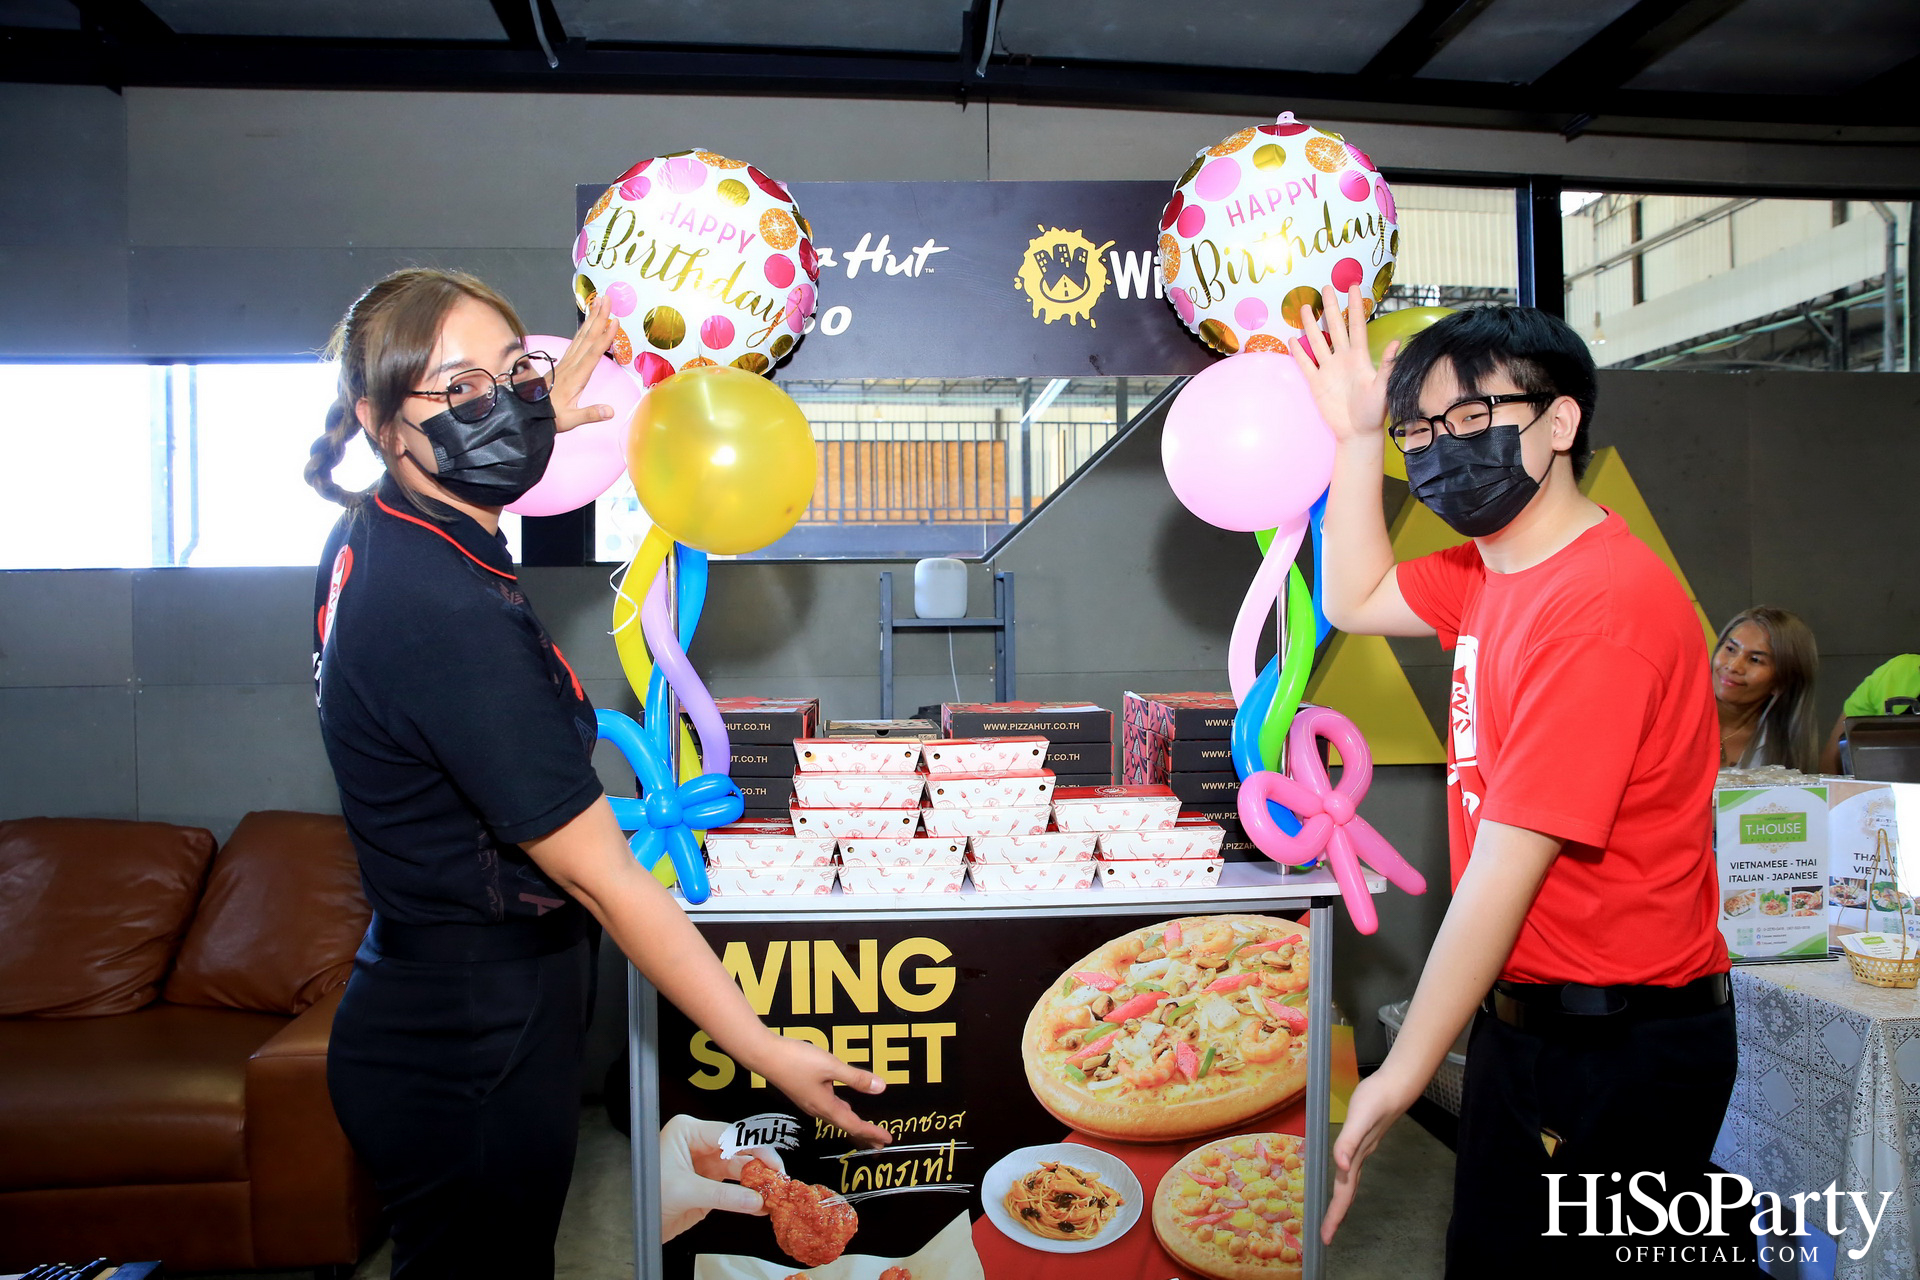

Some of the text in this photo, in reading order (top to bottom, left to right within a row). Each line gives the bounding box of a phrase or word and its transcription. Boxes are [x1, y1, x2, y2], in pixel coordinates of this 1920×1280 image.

[1225, 173, 1318, 228] HAPPY
[660, 201, 756, 254] HAPPY
[1181, 185, 1389, 310] Birthday
[585, 206, 803, 348] Birthday
[983, 722, 1080, 731] WWW.PIZZAHUT.CO.TH
[1745, 822, 1801, 836] T.HOUSE
[1728, 873, 1764, 883] ITALIAN
[1771, 871, 1819, 882] JAPANESE
[1730, 860, 1788, 870] VIETNAMESE
[1796, 858, 1817, 867] THAI
[1853, 865, 1897, 877] VIETNA
[721, 937, 956, 1015] WING
[688, 1022, 957, 1091] SEET
[735, 1119, 787, 1147] ใหม่!
[839, 1138, 956, 1194] โคตรเท่!
